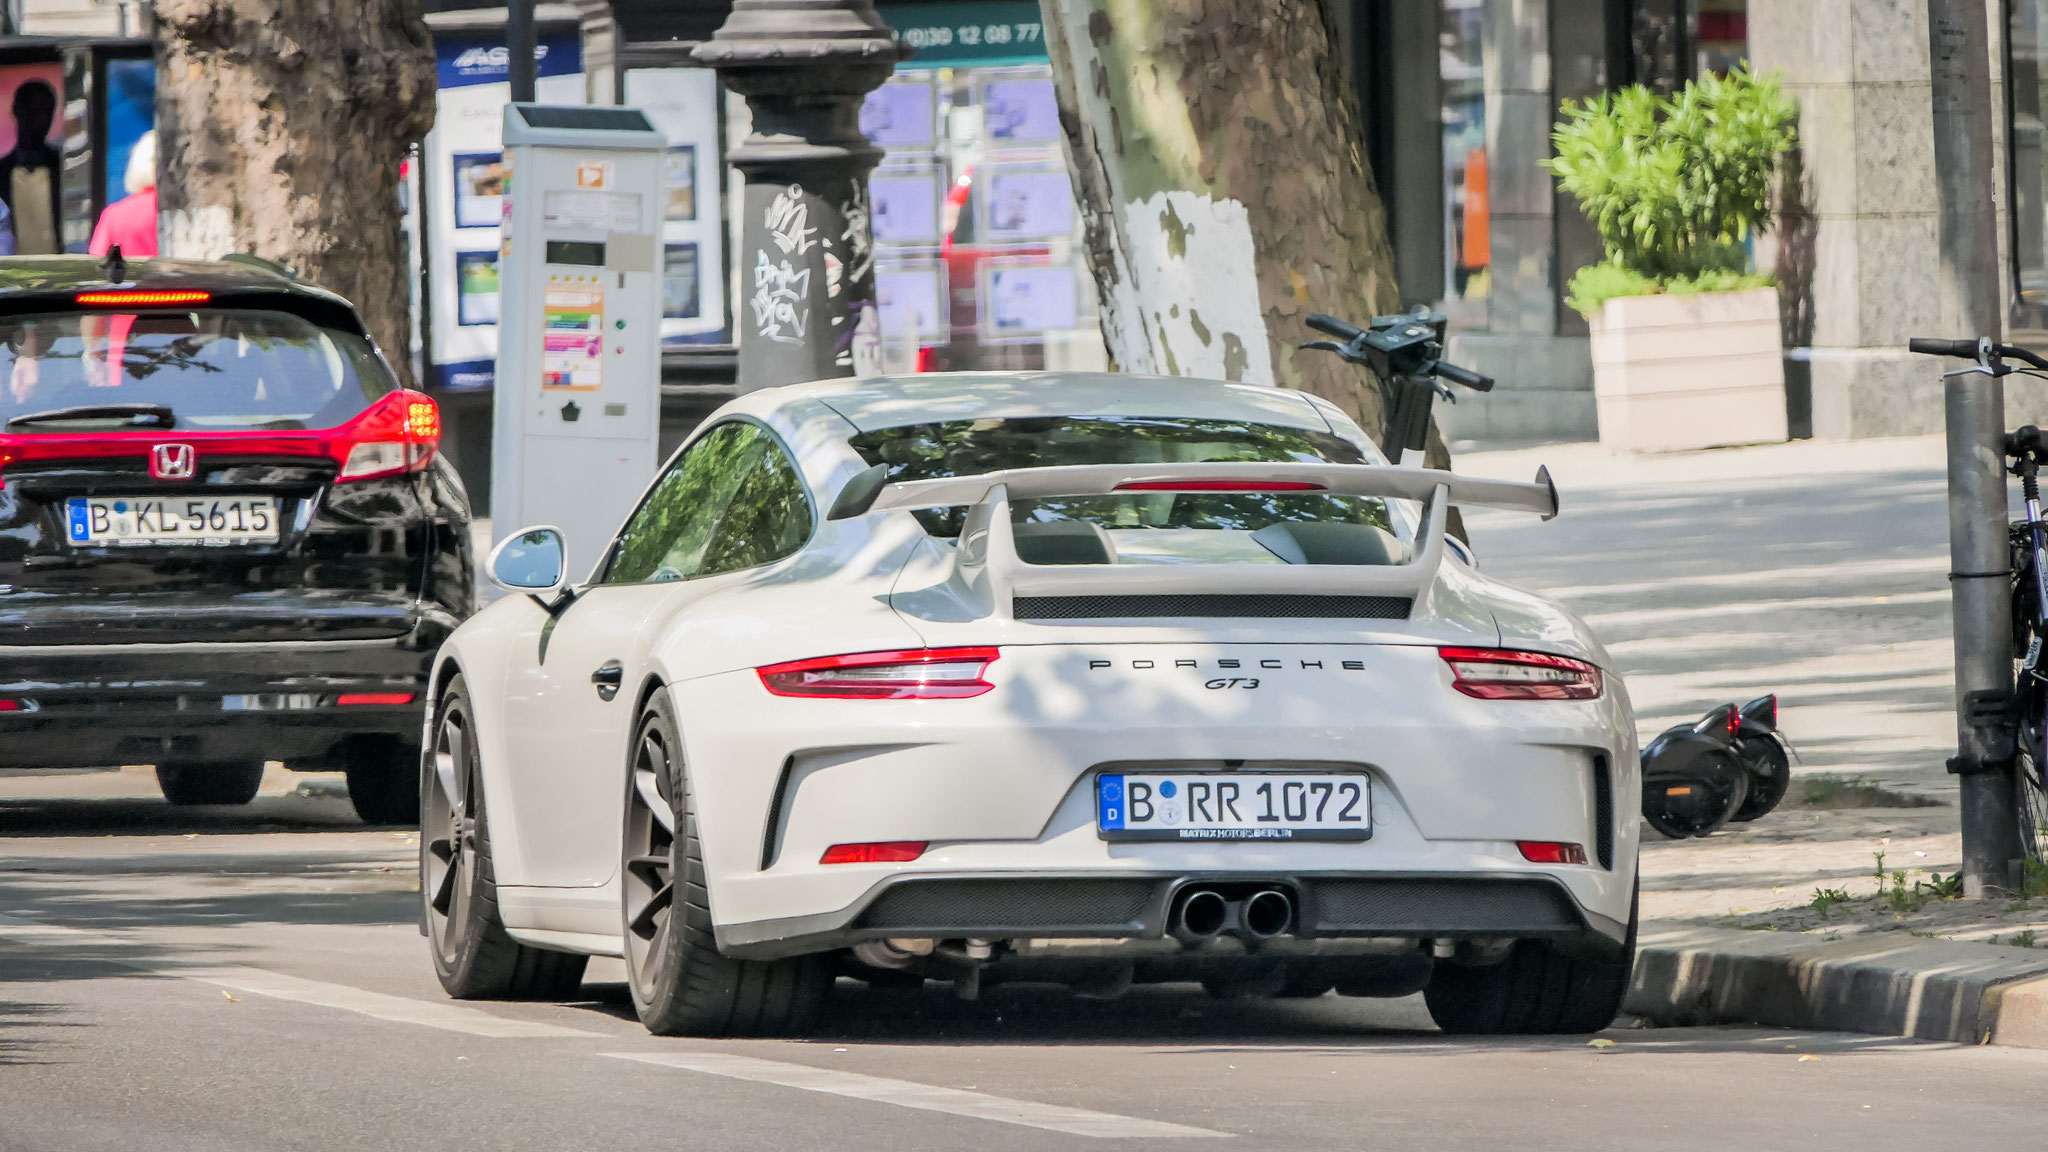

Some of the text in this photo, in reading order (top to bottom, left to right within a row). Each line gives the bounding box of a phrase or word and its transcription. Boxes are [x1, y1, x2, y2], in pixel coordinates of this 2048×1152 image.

[957, 26, 981, 44] 12
[1015, 23, 1040, 42] 77
[91, 501, 268, 534] B KL 5615
[1089, 659, 1365, 670] PORSCHE
[1204, 677, 1260, 690] GT3
[1128, 782, 1362, 822] B RR 1072
[1107, 808, 1118, 820] D
